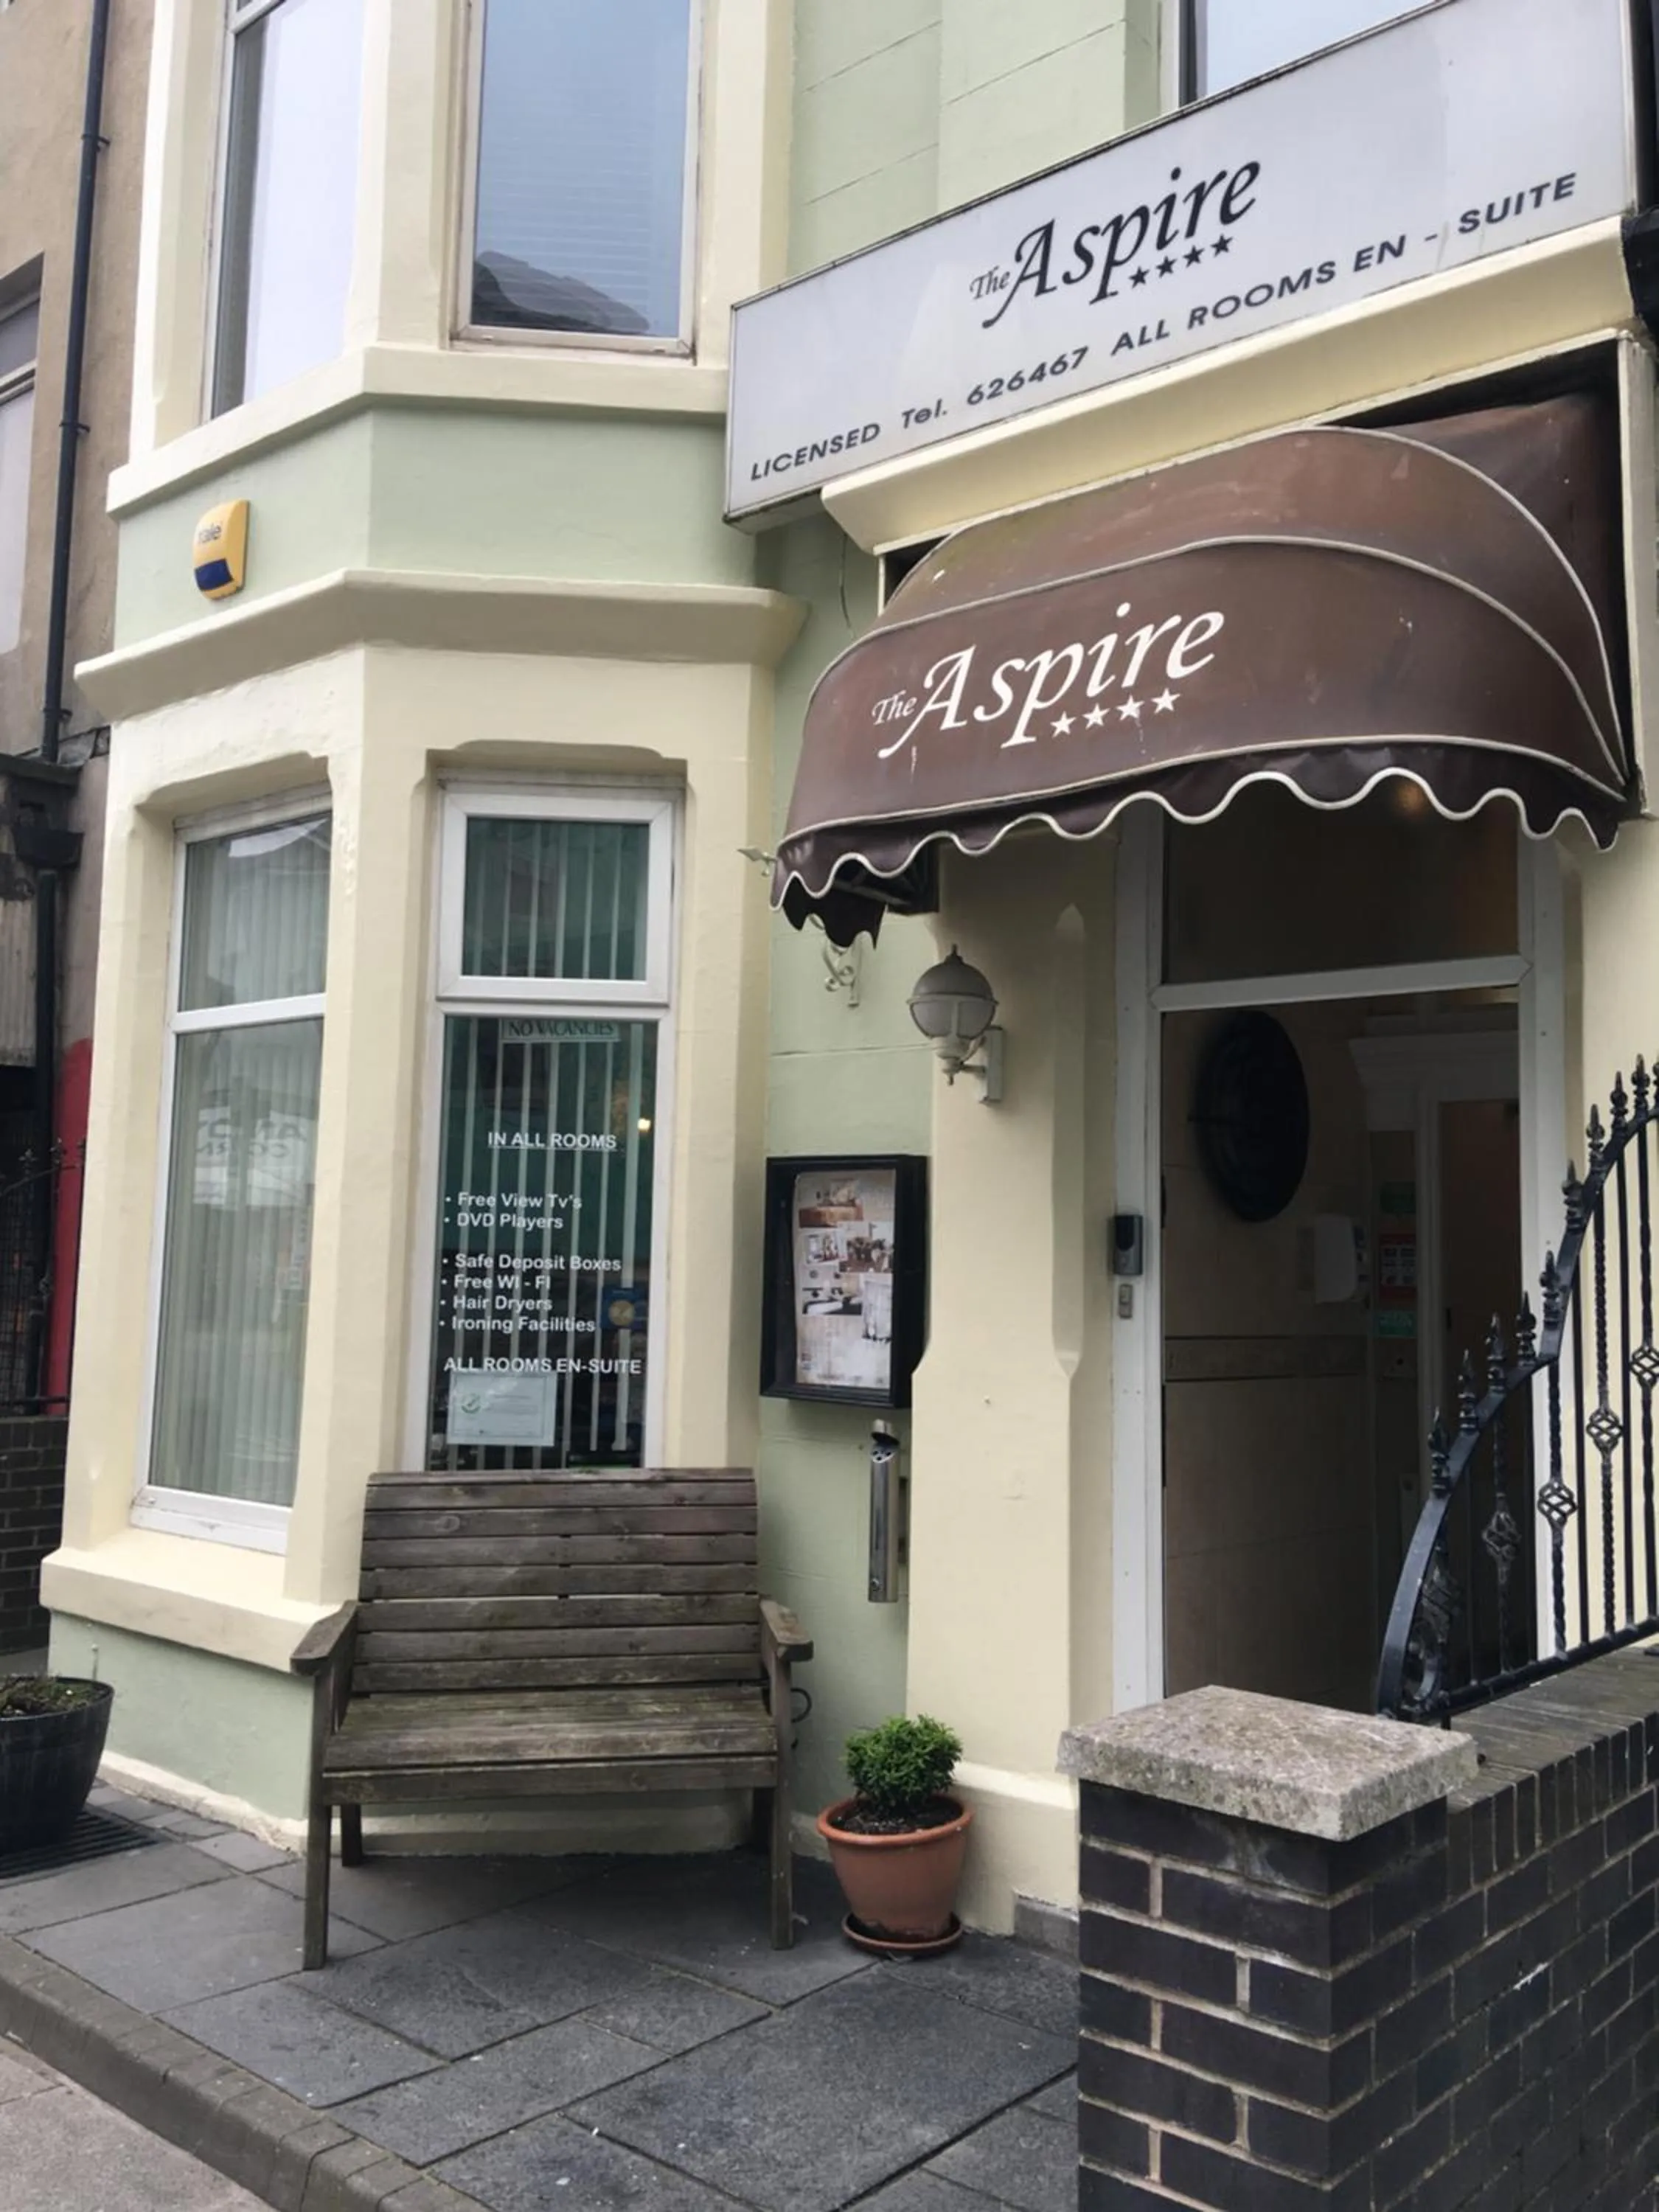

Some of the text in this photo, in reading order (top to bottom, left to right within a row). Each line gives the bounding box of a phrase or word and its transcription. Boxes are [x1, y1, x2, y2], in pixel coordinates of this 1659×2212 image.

[970, 161, 1261, 329] The Aspire
[751, 422, 881, 481] LICENSED
[901, 399, 947, 429] Tel.
[966, 345, 1090, 406] 626467
[1110, 319, 1171, 355] ALL
[1187, 260, 1337, 330] ROOMS
[1352, 234, 1407, 273] EN
[1458, 173, 1576, 234] SUITE
[872, 602, 1225, 759] The Aspire
[508, 1019, 532, 1037] NO
[488, 1132, 617, 1149] IN ALL ROOMS
[457, 1192, 582, 1209] Free View Tv's
[456, 1213, 563, 1231] DVD Players
[455, 1253, 622, 1272] Safe Deposit Boxes
[453, 1274, 493, 1289] Free
[453, 1295, 553, 1313] Hair Dryers
[451, 1316, 597, 1334] Ironing Facilities
[443, 1357, 642, 1374] ALL ROOMS EN-SUITE
